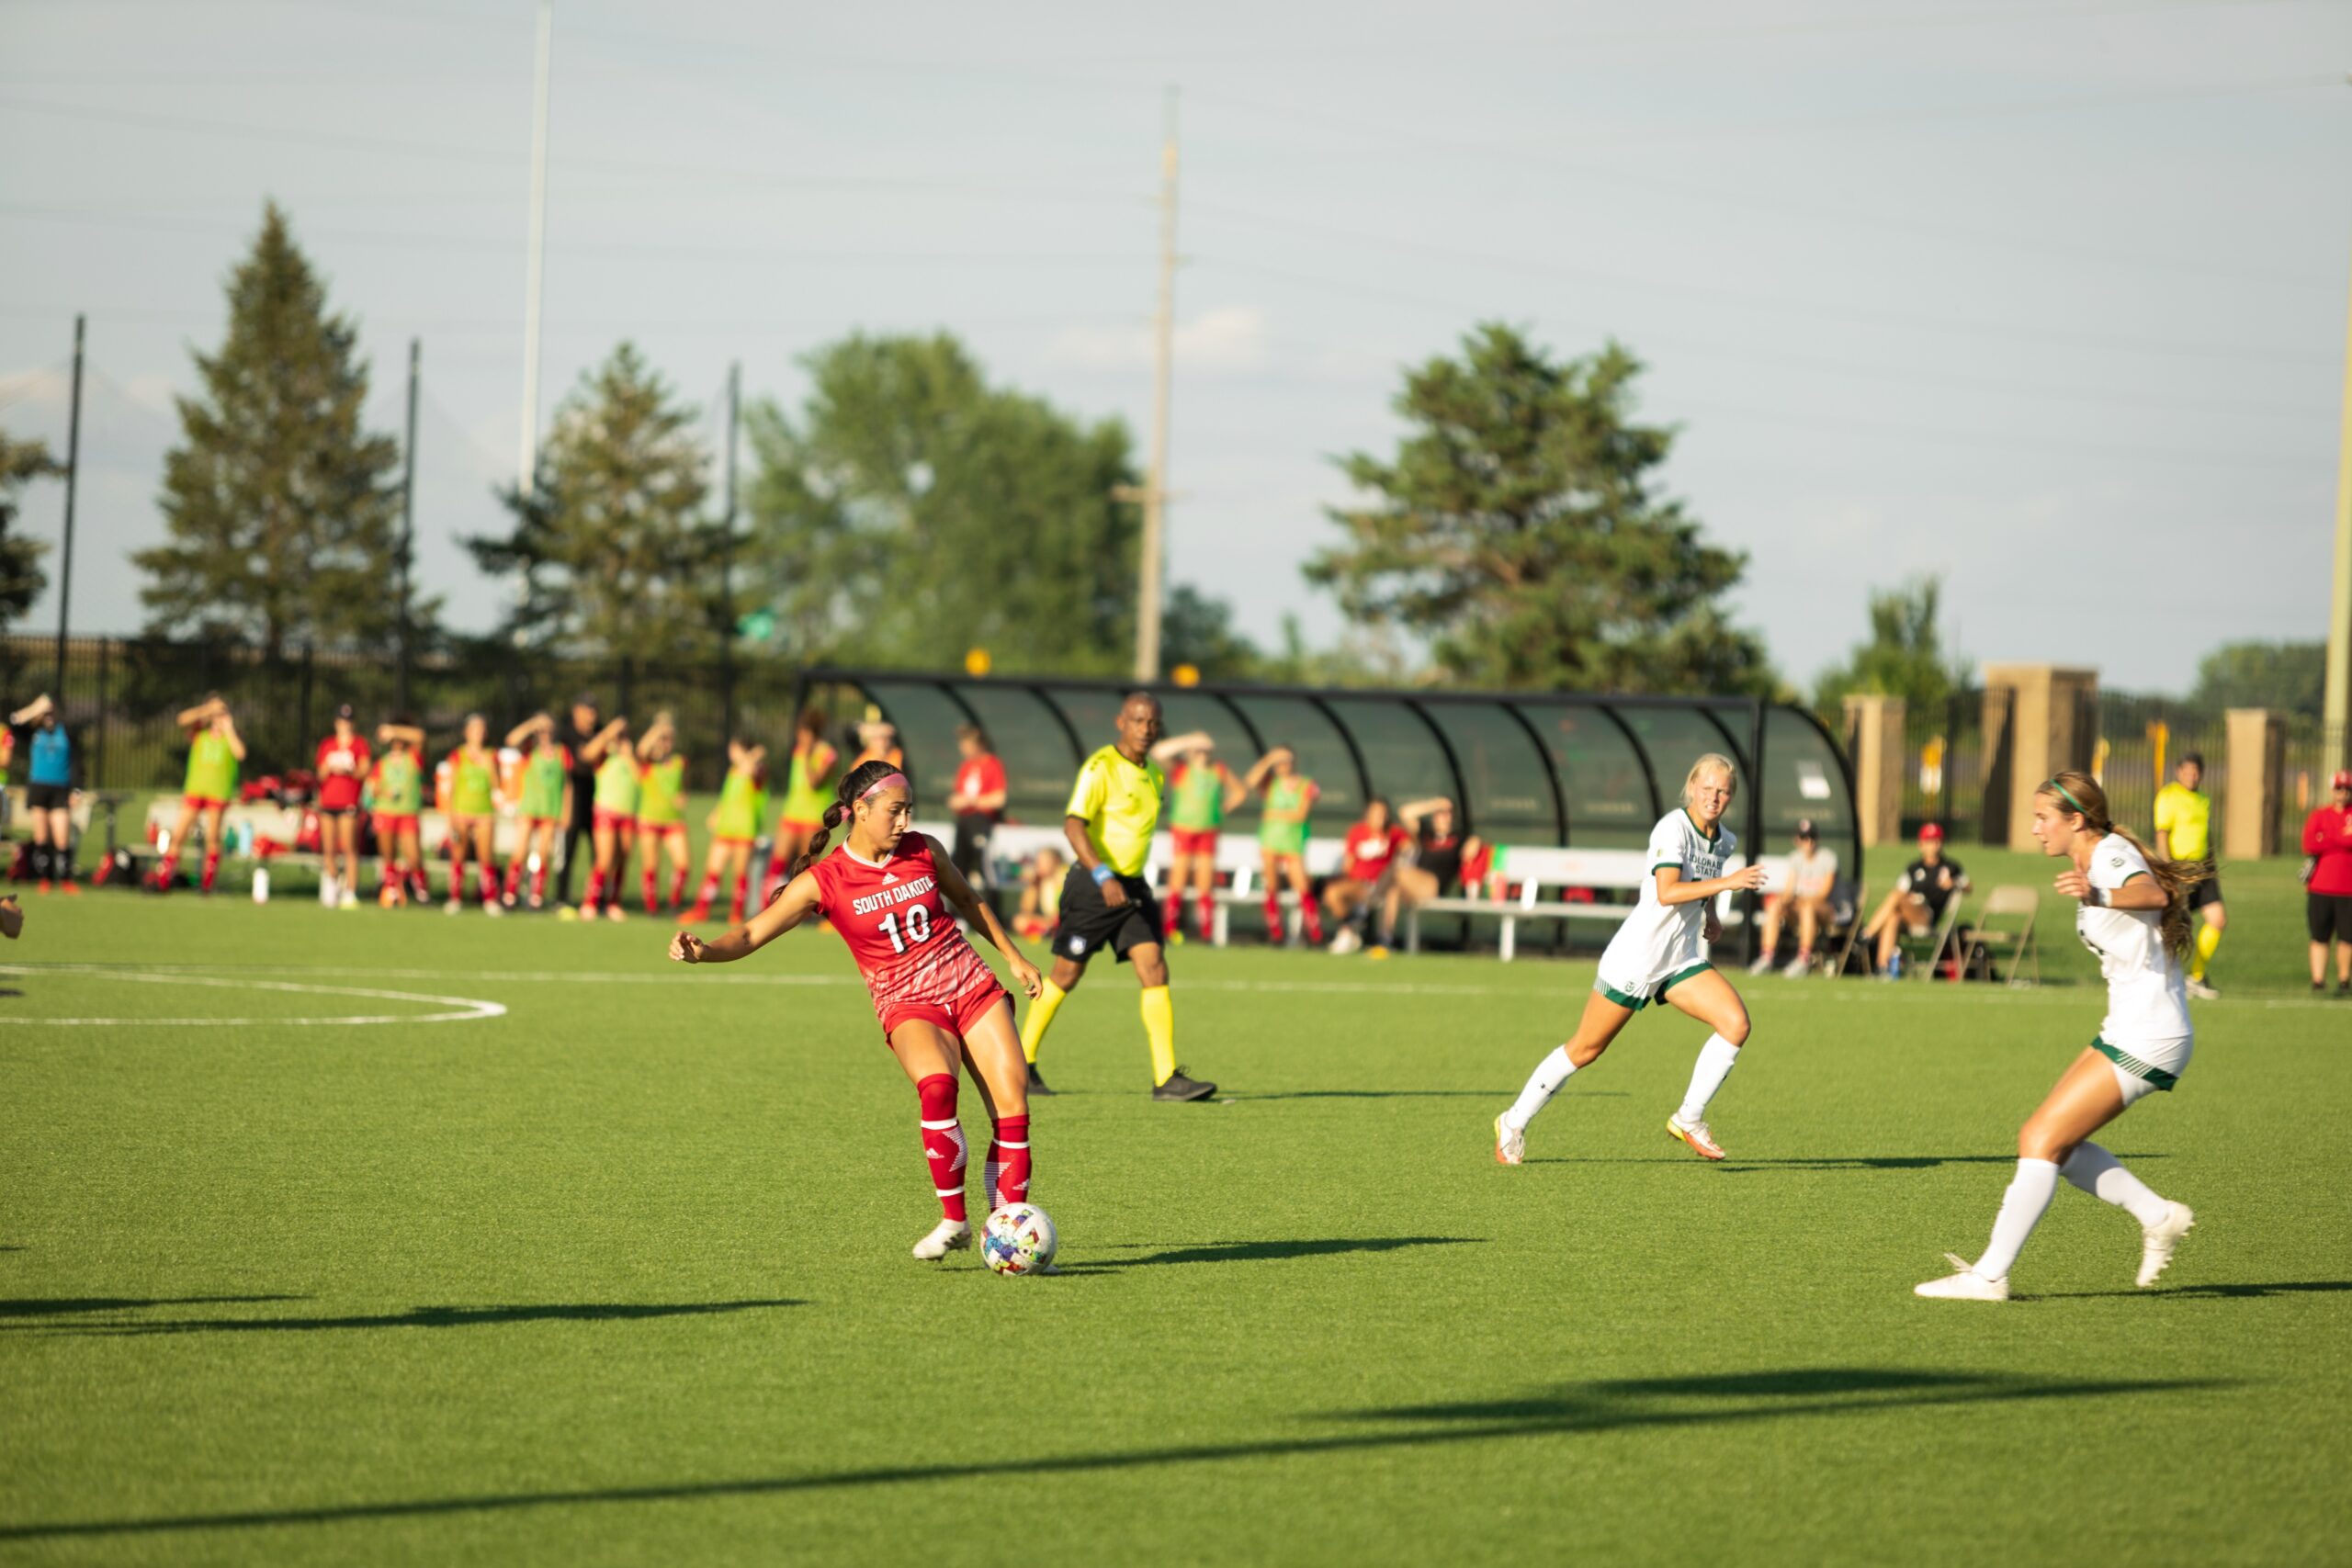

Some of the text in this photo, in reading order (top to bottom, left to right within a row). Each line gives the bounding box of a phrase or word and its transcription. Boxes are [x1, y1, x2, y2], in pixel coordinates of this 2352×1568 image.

[1696, 864, 1718, 878] STATE
[853, 875, 934, 916] SOUTH DAKOTA
[877, 904, 932, 953] 10
